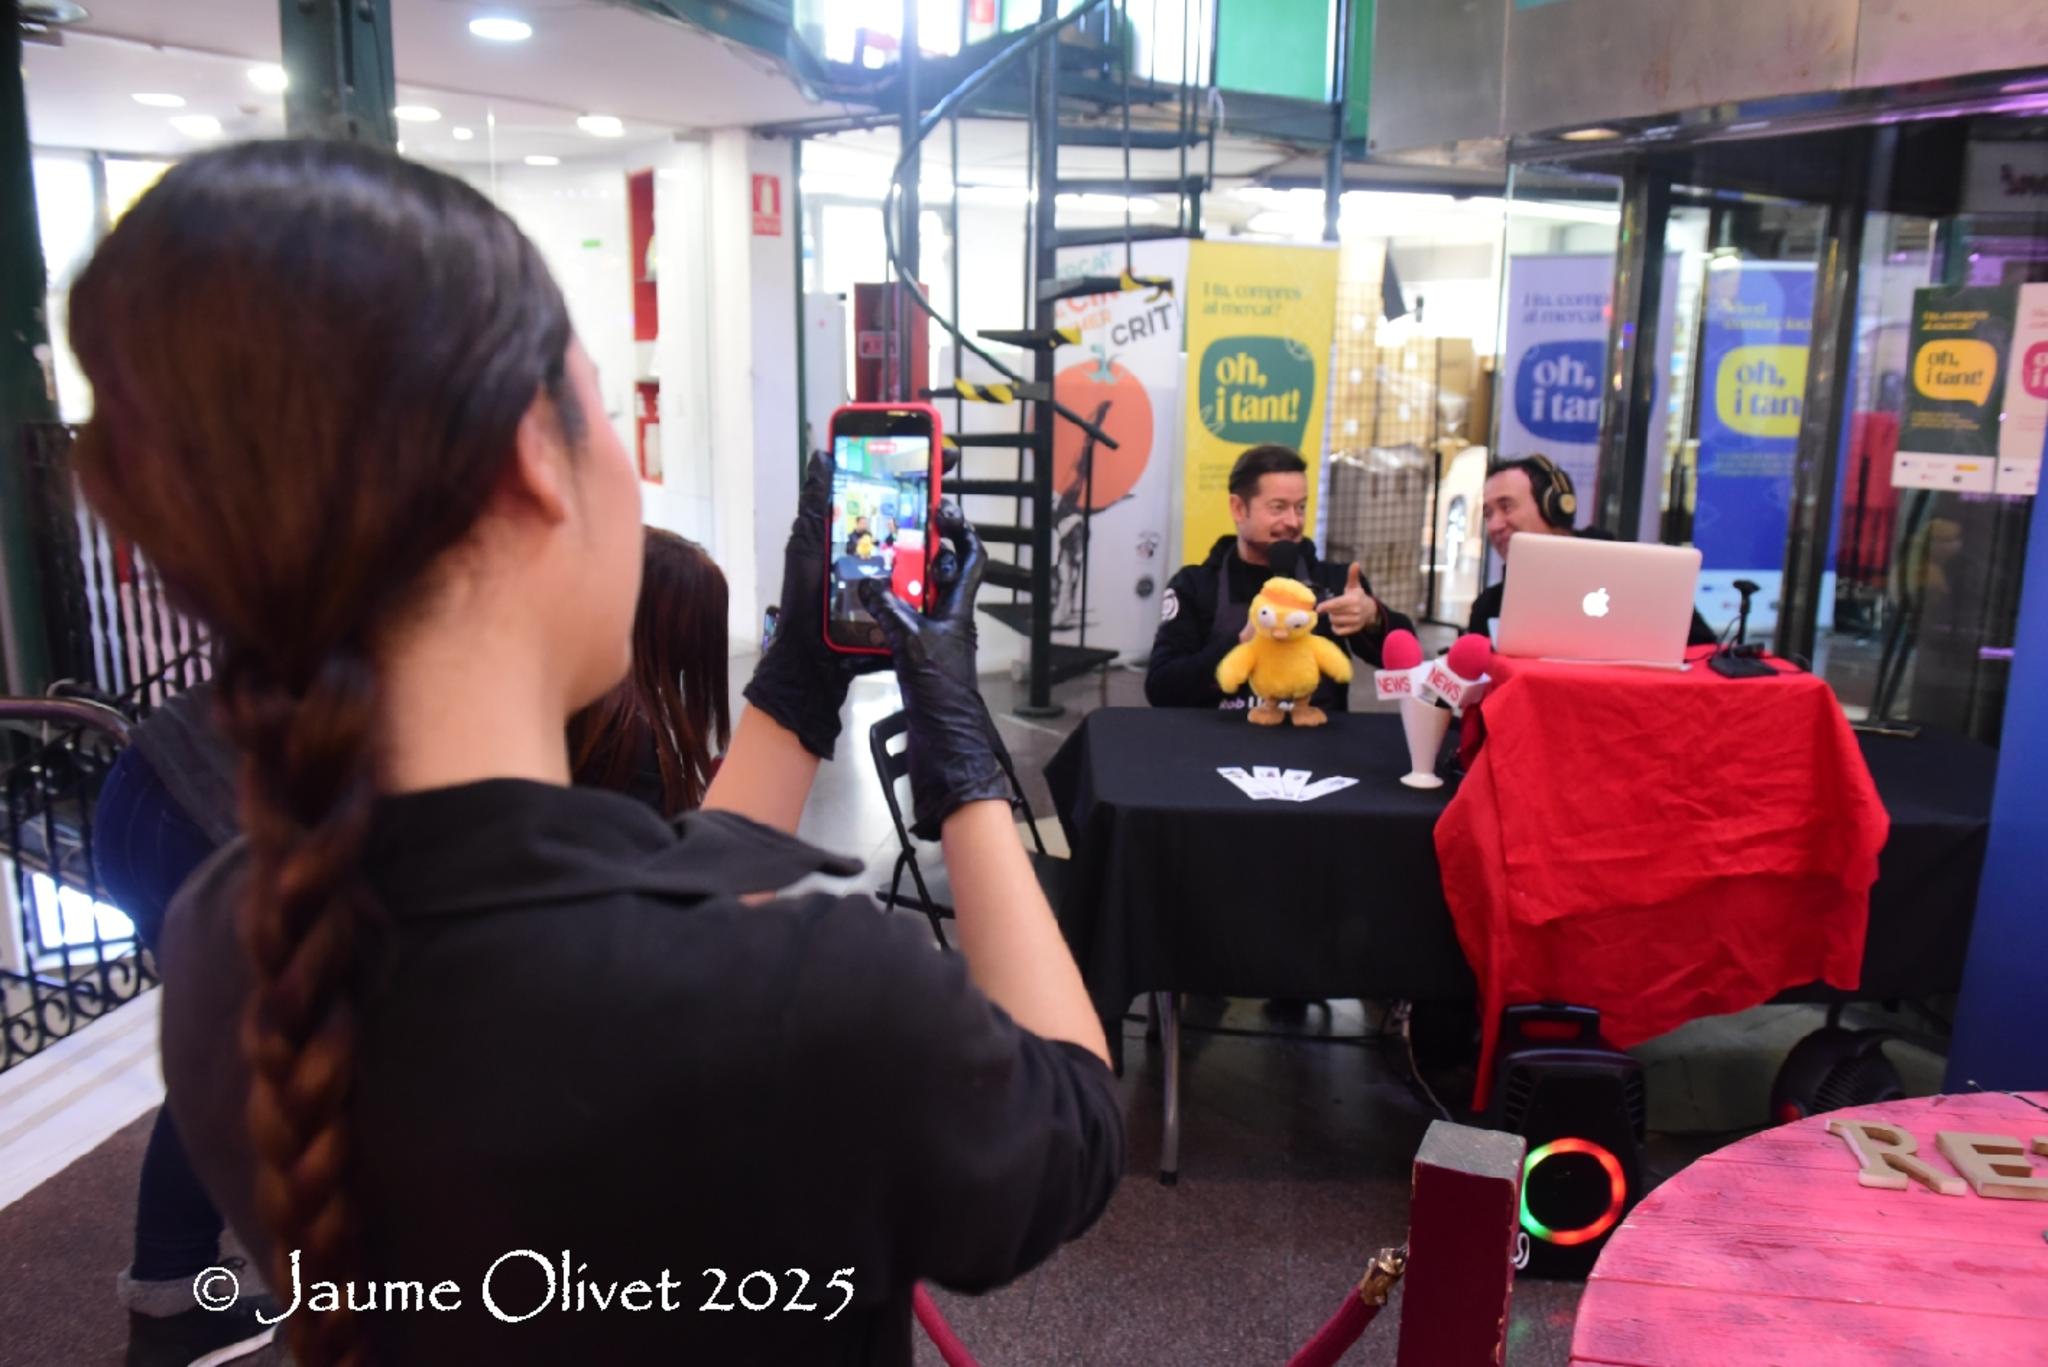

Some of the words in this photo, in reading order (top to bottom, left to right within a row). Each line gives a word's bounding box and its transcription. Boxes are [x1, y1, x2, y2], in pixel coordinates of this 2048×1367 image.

[1111, 302, 1172, 347] CRIT
[1216, 352, 1267, 388] oh,
[1533, 353, 1595, 391] oh,
[1735, 360, 1785, 388] oh,
[1216, 386, 1226, 424] i
[1231, 388, 1299, 423] tant!
[1532, 388, 1545, 422] i
[1735, 386, 1743, 416] i
[1378, 676, 1412, 694] NEWS
[1428, 667, 1461, 702] NEWS
